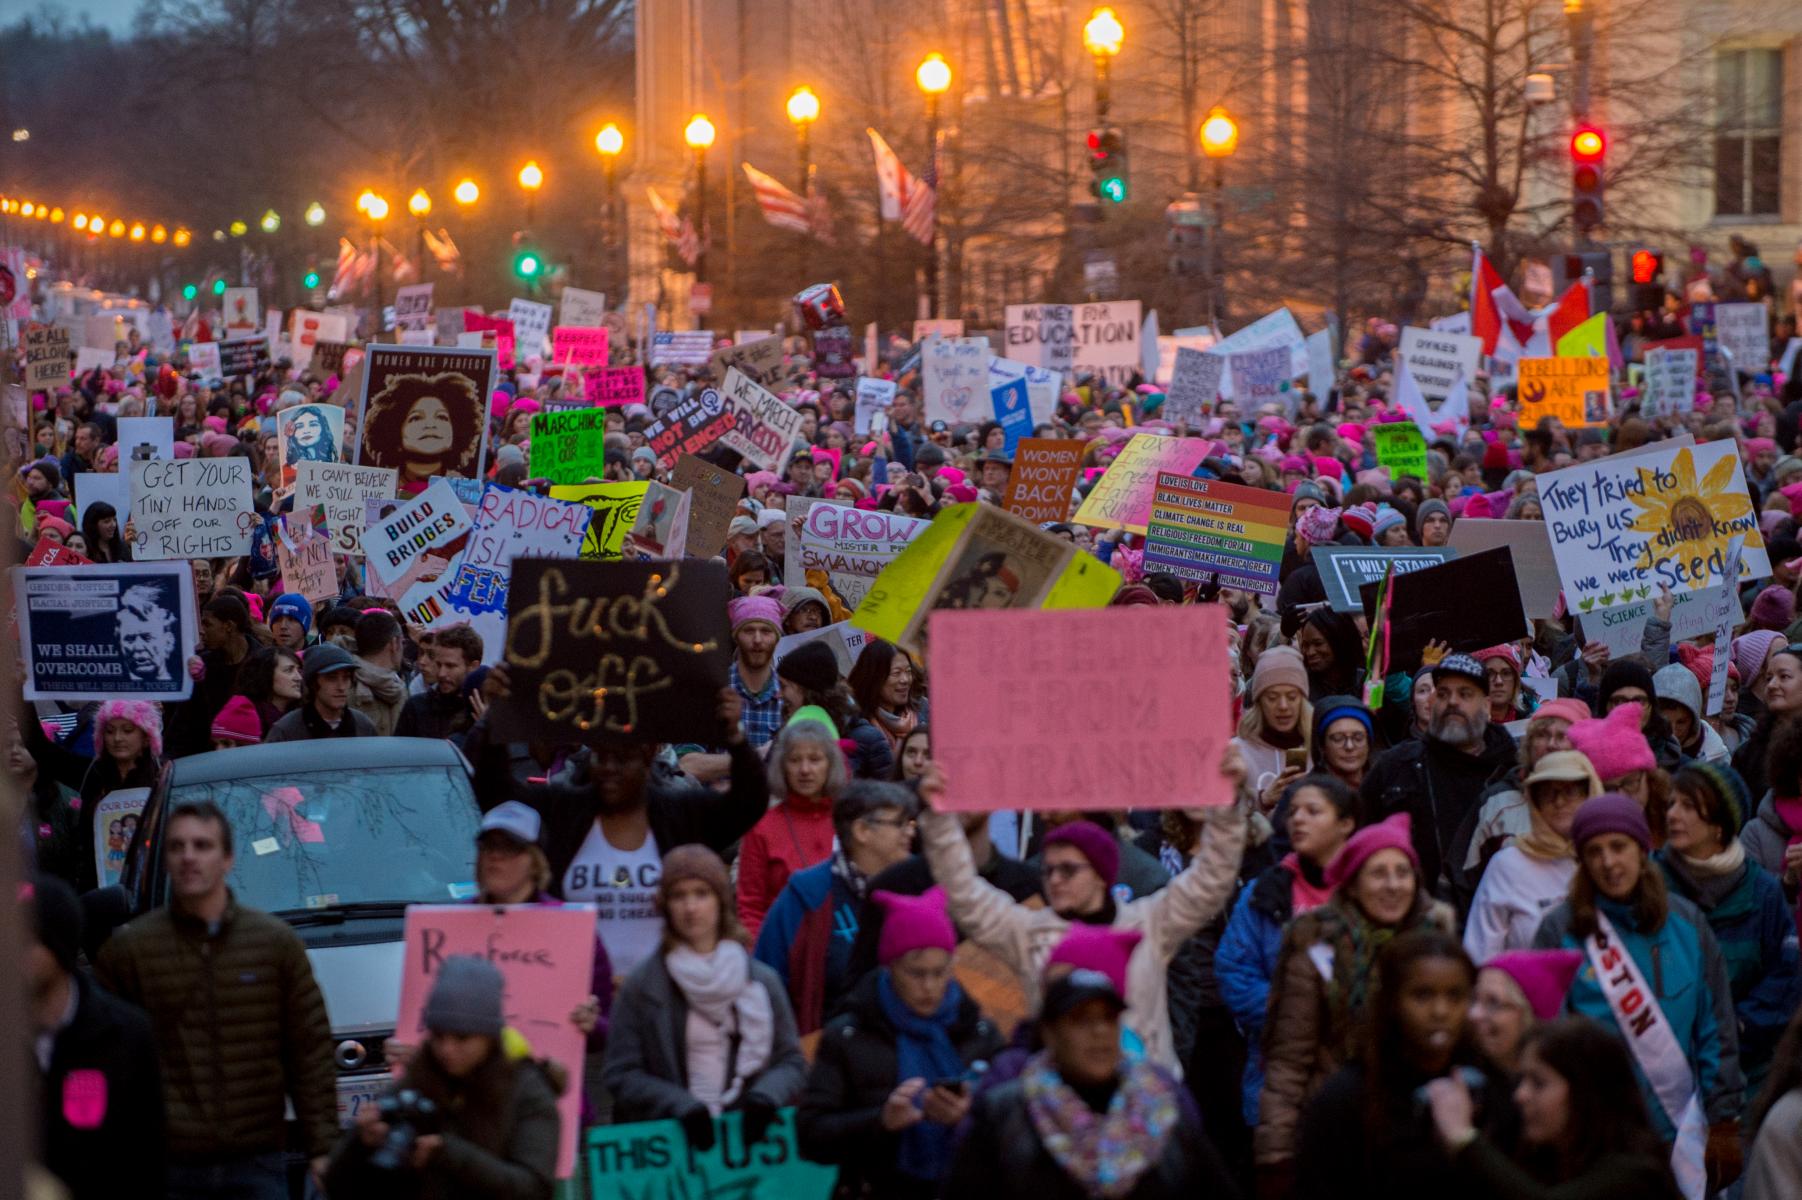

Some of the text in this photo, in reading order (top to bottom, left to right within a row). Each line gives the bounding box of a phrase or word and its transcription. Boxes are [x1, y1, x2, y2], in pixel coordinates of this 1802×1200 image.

[1023, 304, 1111, 321] MONEY FOR
[26, 328, 69, 344] WE ALL
[1008, 320, 1134, 345] EDUCATION
[34, 362, 66, 378] HERE
[375, 354, 487, 370] WOMEN ARE PERFECT
[1409, 354, 1463, 371] AGAINST
[1551, 379, 1581, 398] ARE
[733, 374, 759, 406] WE
[756, 393, 798, 436] MARCH
[534, 411, 605, 437] MARCHING
[643, 398, 699, 439] WE WILL
[557, 433, 579, 448] FOR
[650, 408, 708, 454] NOT BE
[1023, 450, 1078, 463] WOMEN
[143, 461, 245, 488] GET YOUR
[354, 472, 390, 488] BELIEVE
[1019, 466, 1073, 481] WON'T
[1161, 475, 1208, 492] LOVE IS LOVE
[306, 484, 384, 501] WE STILL HAVE
[1013, 484, 1068, 502] BACK
[1542, 480, 1590, 515] They
[1654, 467, 1677, 492] to
[137, 494, 237, 515] TINY HANDS
[328, 505, 363, 521] FIGHT
[1009, 504, 1063, 520] DOWN
[1158, 493, 1232, 514] BLACK LIVES MATTER
[151, 518, 221, 532] OFF OUR
[384, 501, 434, 541] BUILD
[479, 494, 587, 536] RADICAL
[809, 505, 919, 542] GROW
[1154, 510, 1245, 534] CLIMATE CHANGE IS REAL
[160, 535, 232, 555] RIGHTS
[386, 512, 455, 567] BRIDGES
[834, 541, 878, 552] MISTER
[1151, 526, 1252, 552] RELIGIOUS FREEDOM FOR ALL
[1601, 512, 1756, 569] They didn't know
[1148, 543, 1272, 574] IMMIGRANTS MAKE AMERICA GREAT
[1357, 560, 1387, 573] WILL
[1394, 560, 1439, 573] STAND
[29, 582, 115, 592] GENDER JUSTICE
[1145, 561, 1178, 576] WOMEN'S
[1180, 567, 1204, 580] RIGHTS
[1221, 574, 1246, 587] HUMAN
[1248, 580, 1273, 592] RIGHTS
[1574, 576, 1600, 592] we
[1608, 567, 1649, 584] were
[32, 599, 113, 609] RACIAL JUSTICE
[862, 589, 888, 613] NO
[1602, 591, 1692, 627] SCIENCE EAL
[507, 563, 718, 669] fuck
[37, 644, 118, 656] WE SHALL
[938, 611, 1221, 677] FREEDOM
[35, 662, 122, 675] OVERCOMB
[42, 681, 75, 691] THERE
[77, 681, 100, 691] WILL
[101, 682, 114, 691] BE
[117, 682, 142, 691] HELL
[539, 654, 673, 731] off
[997, 677, 1160, 735] FROM
[941, 736, 1215, 800] TYRANNY
[571, 863, 659, 890] BLAC
[597, 893, 656, 903] NO SUGA
[598, 909, 613, 919] NO
[591, 1136, 671, 1173] THIS
